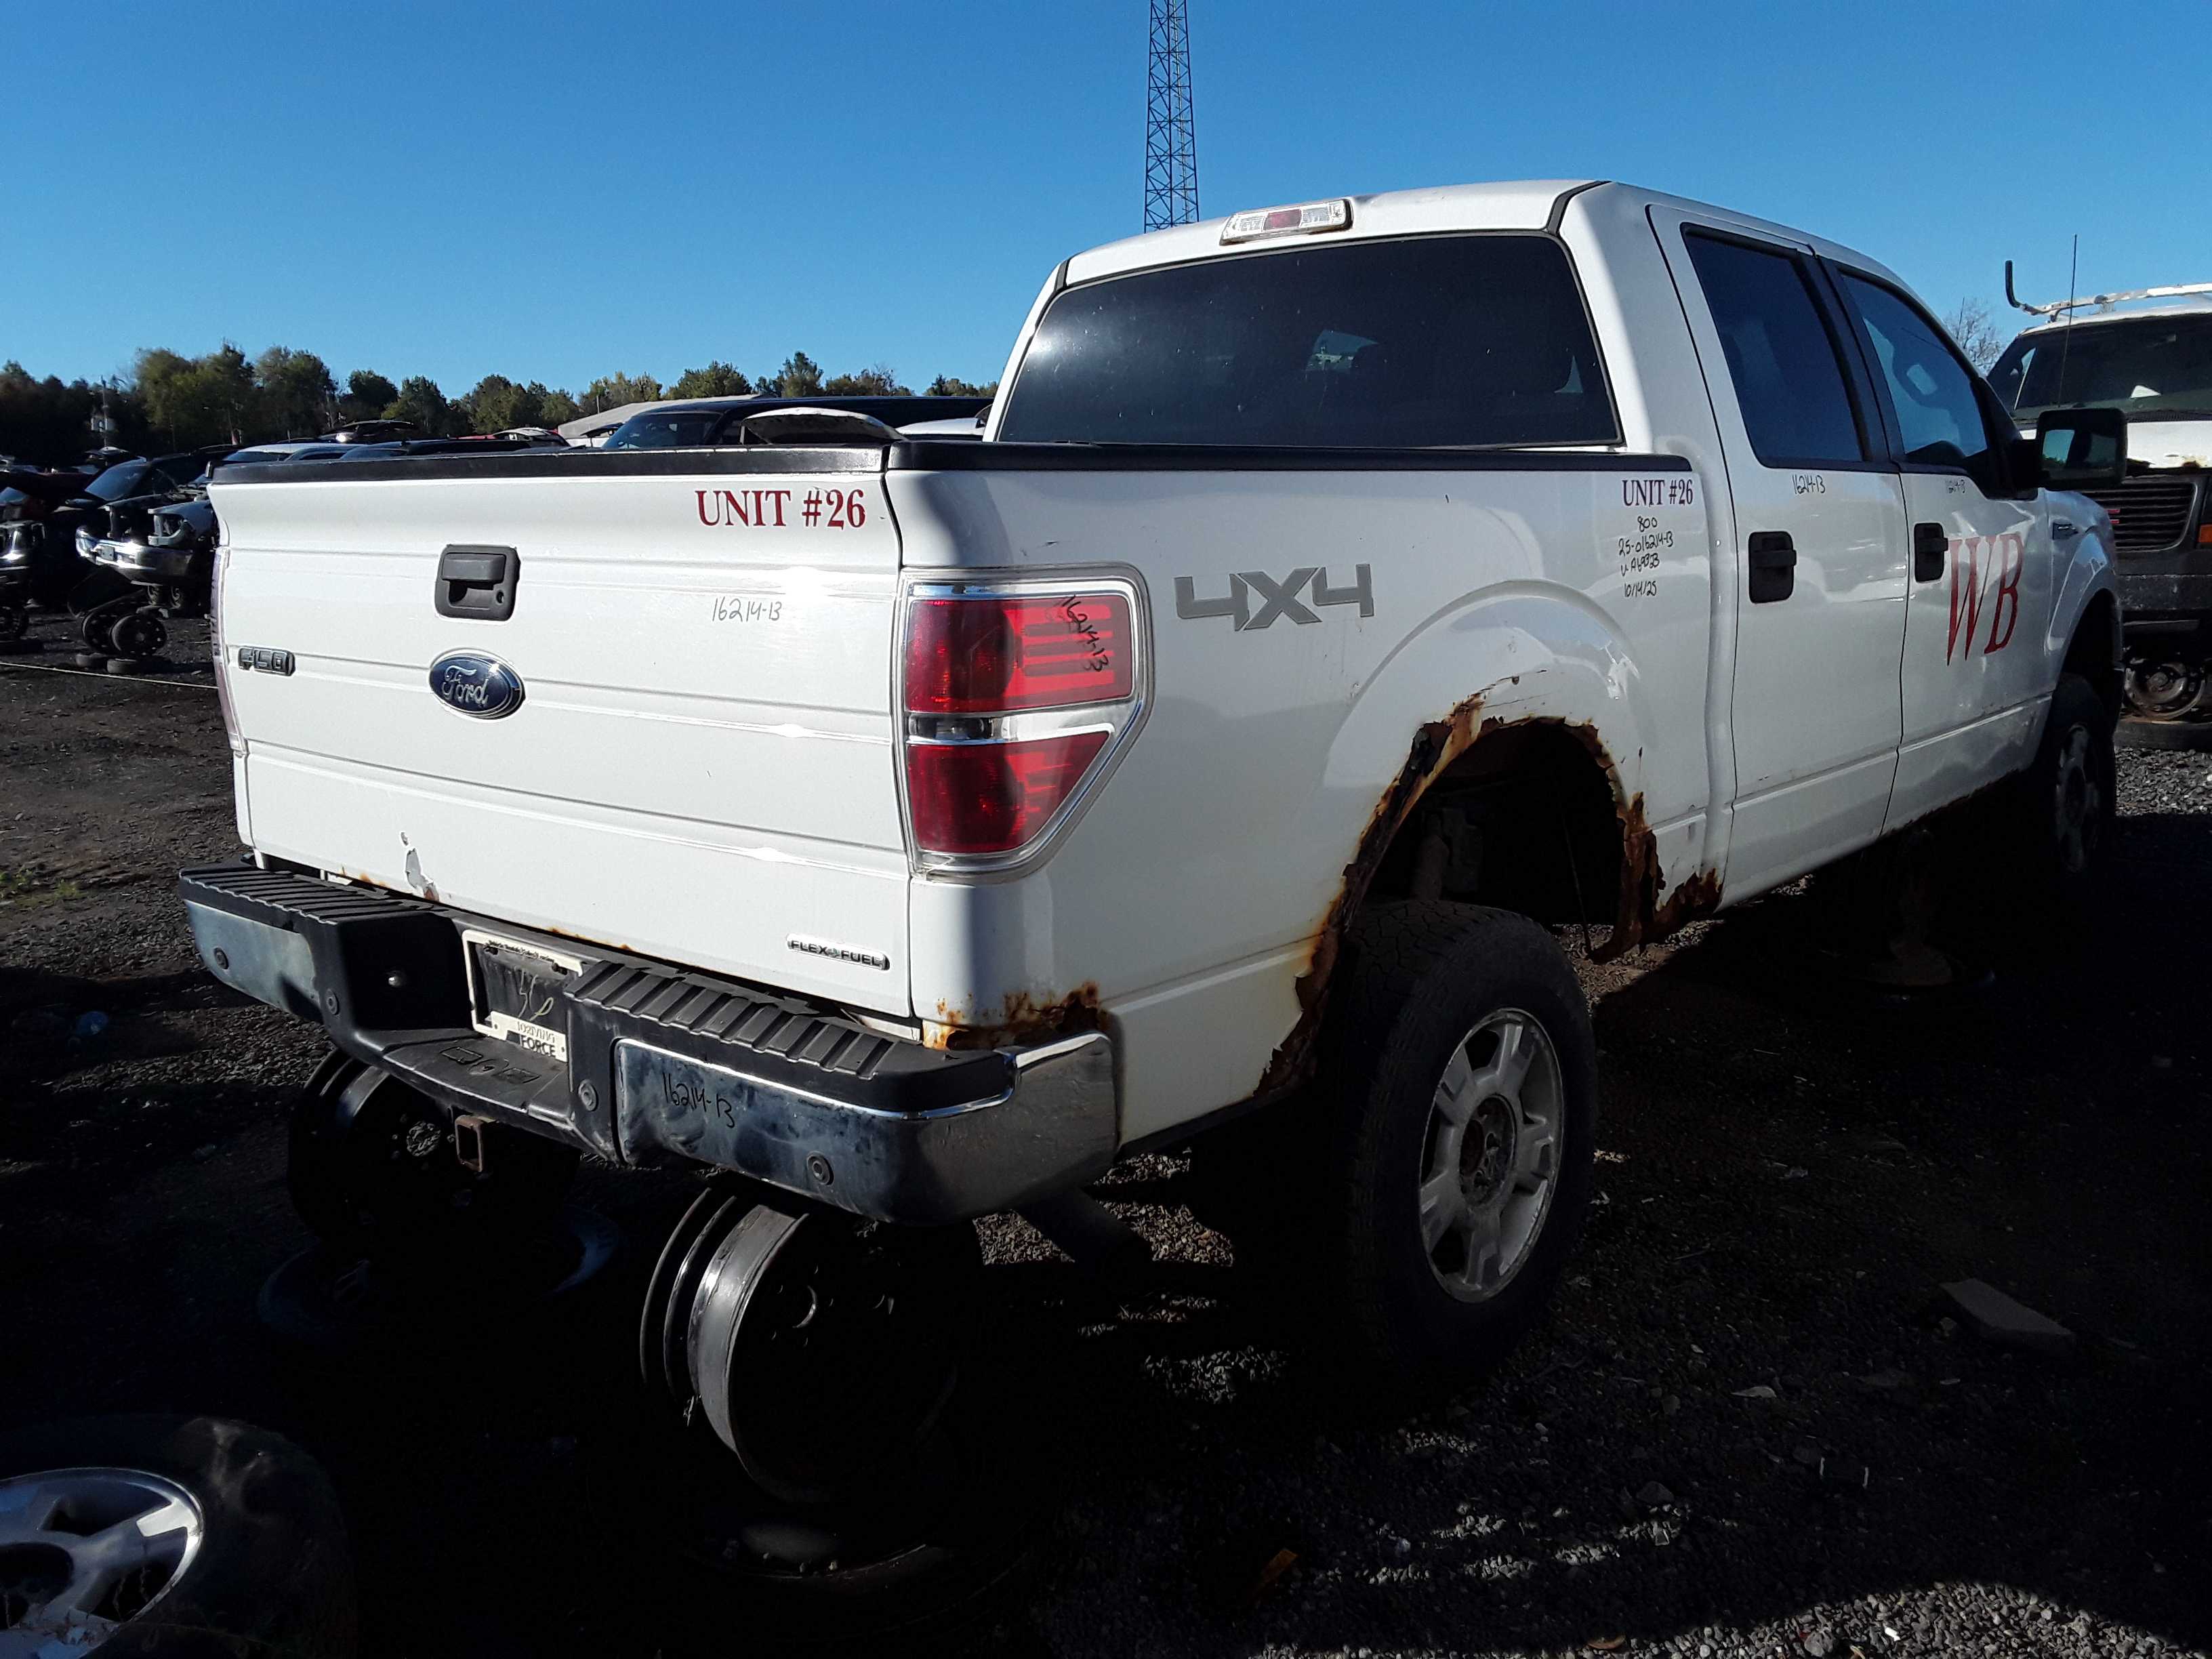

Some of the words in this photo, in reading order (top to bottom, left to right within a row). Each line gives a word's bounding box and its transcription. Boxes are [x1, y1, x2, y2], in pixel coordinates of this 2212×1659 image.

[695, 490, 791, 527] UNIT
[802, 489, 866, 530] #26
[1622, 479, 1665, 506] UNIT
[1668, 478, 1694, 506] #26
[1637, 516, 1658, 533] 800
[1174, 563, 1374, 632] 4X4
[1948, 531, 2024, 666] WB
[441, 665, 489, 707] Ford
[520, 1035, 556, 1057] FORCE
